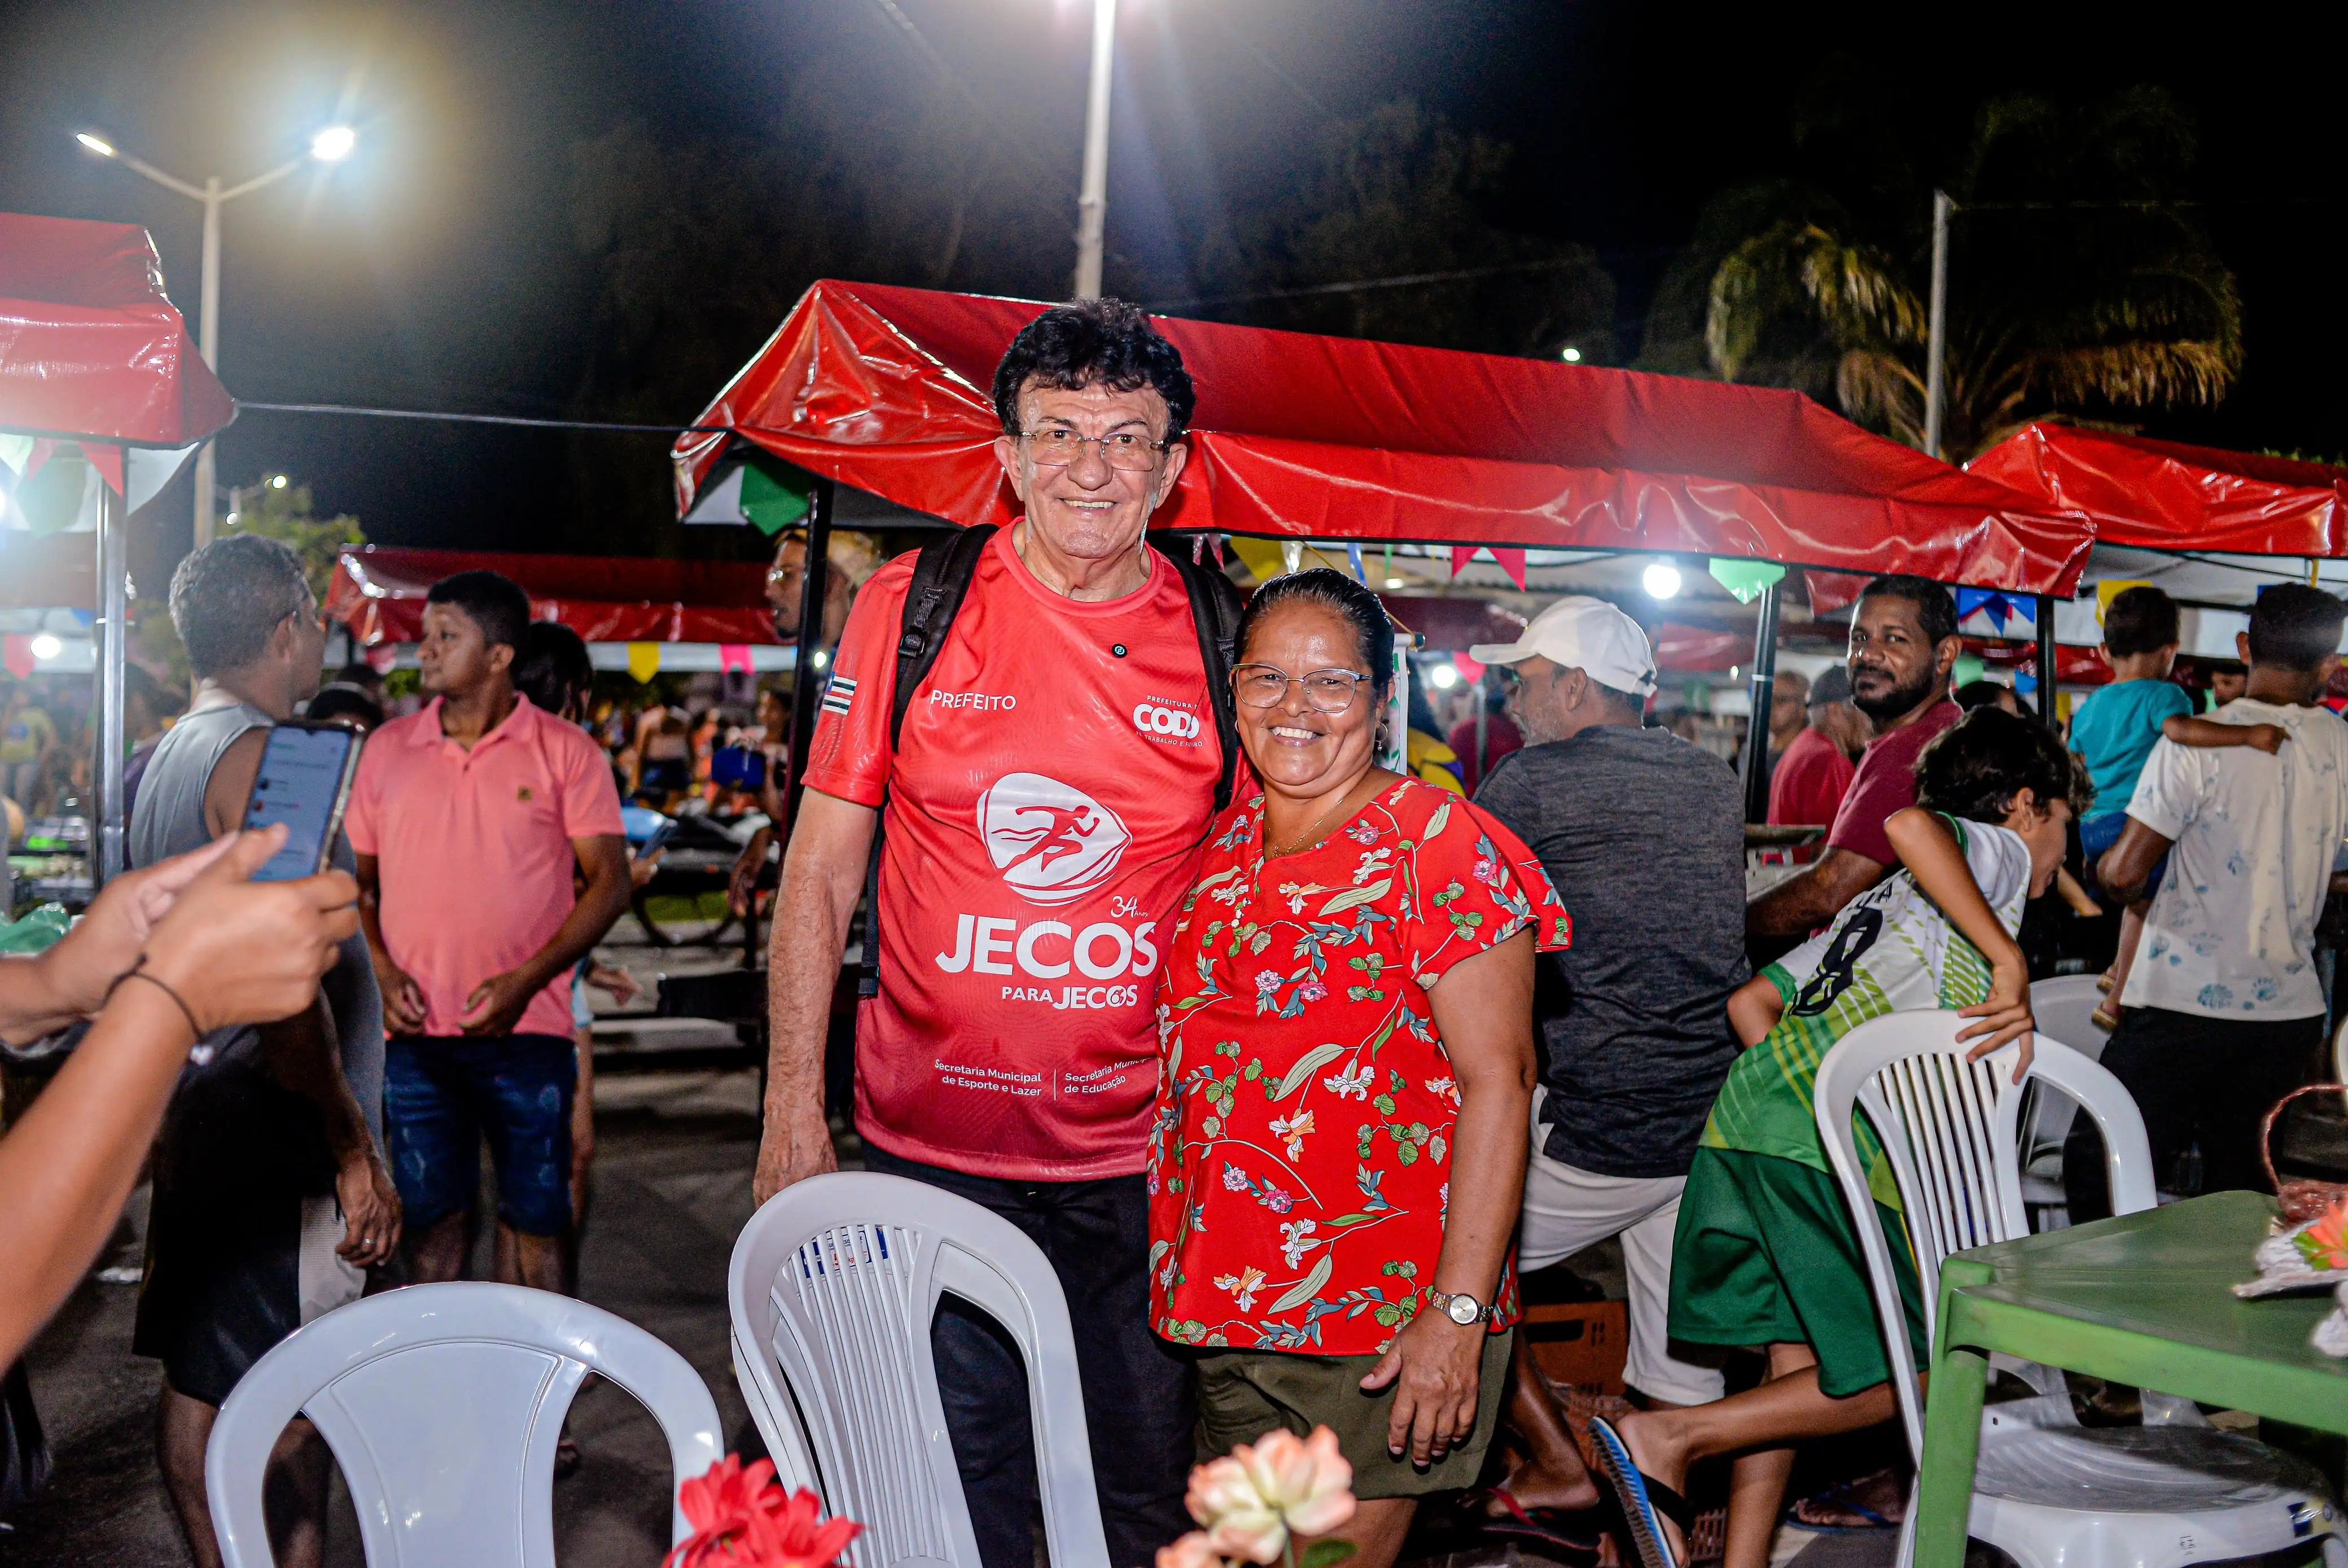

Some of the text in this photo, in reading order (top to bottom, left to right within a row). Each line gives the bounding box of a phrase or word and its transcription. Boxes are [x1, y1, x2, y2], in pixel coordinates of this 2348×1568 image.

[930, 689, 1017, 711] PREFEITO
[1147, 695, 1192, 709] PREFEITURA
[1144, 734, 1177, 745] TRABALHO
[1110, 895, 1137, 918] 34
[935, 913, 1157, 979] JECOS
[1002, 984, 1138, 1010] PARA JECOS
[935, 1059, 1042, 1084] Secretaria Municipal
[1065, 1065, 1112, 1082] Secretaria
[942, 1075, 956, 1084] de
[958, 1077, 999, 1089] Esporte
[1011, 1085, 1042, 1096] Lazer
[1065, 1075, 1126, 1093] de Educação
